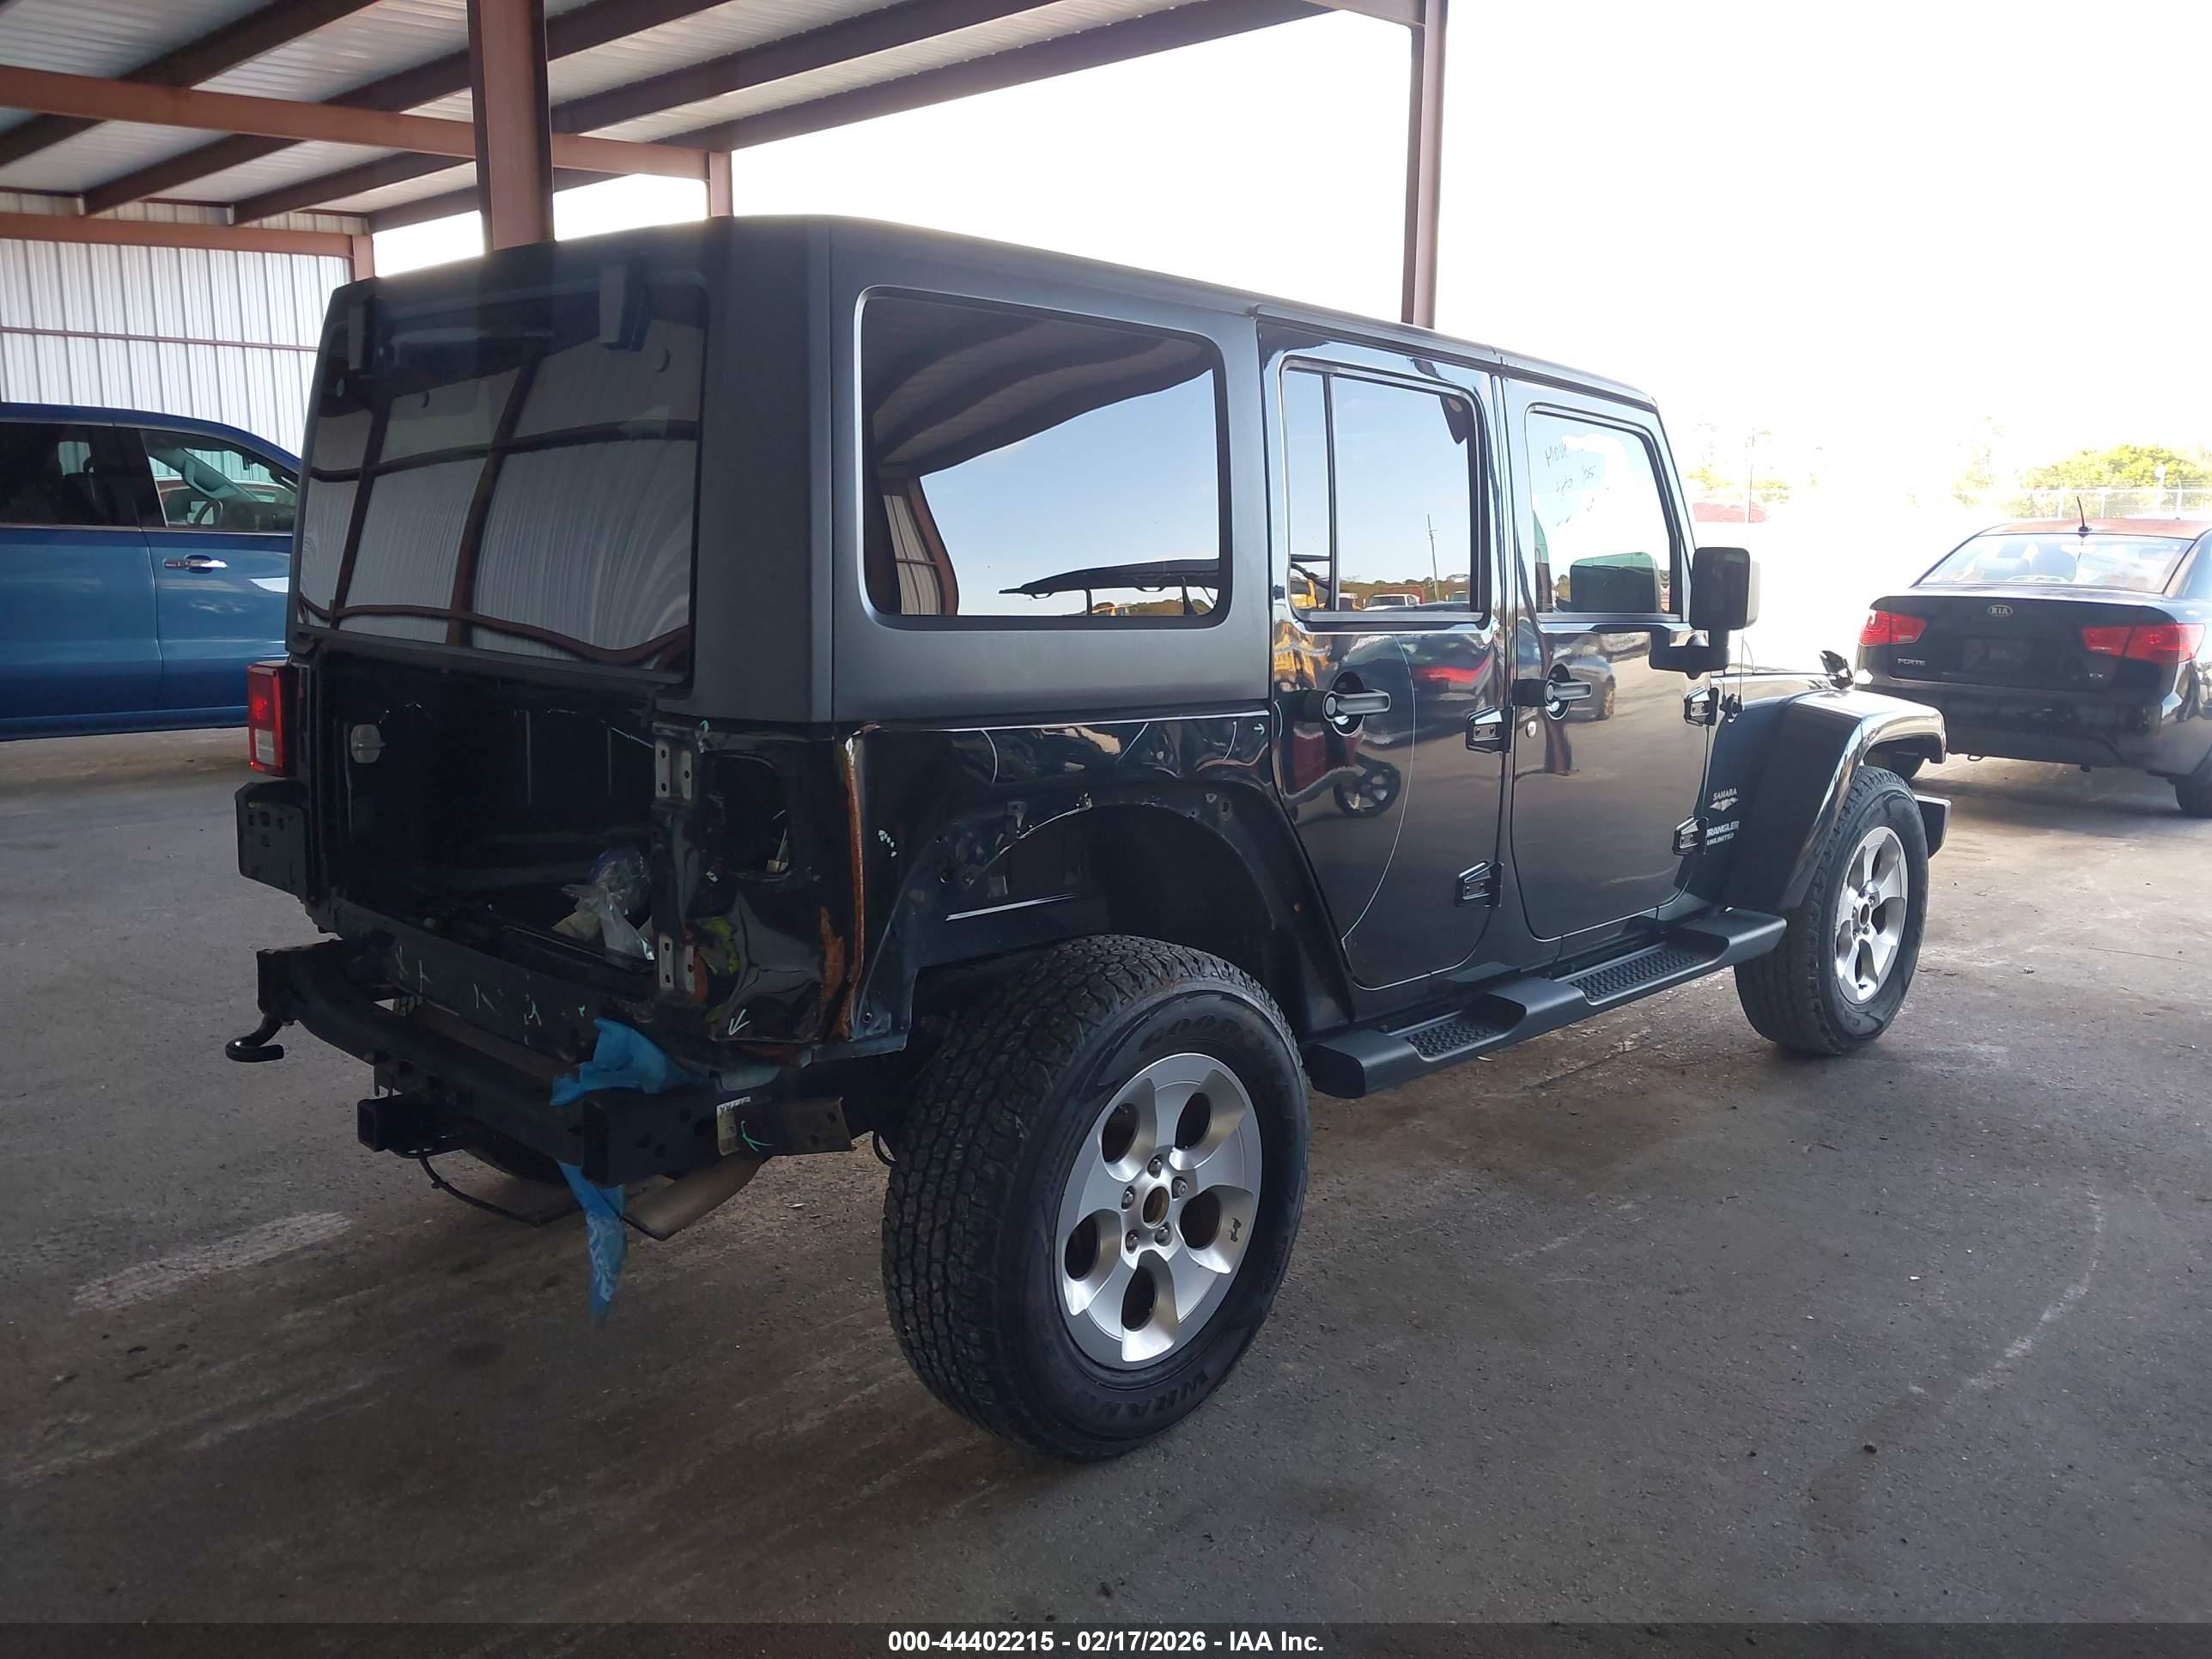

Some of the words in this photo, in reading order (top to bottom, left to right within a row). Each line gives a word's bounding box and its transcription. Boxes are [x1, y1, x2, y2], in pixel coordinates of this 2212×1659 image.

[1990, 606, 2009, 616] KIA
[1897, 658, 1926, 666] FORTE
[1712, 787, 1738, 801] SAHARA
